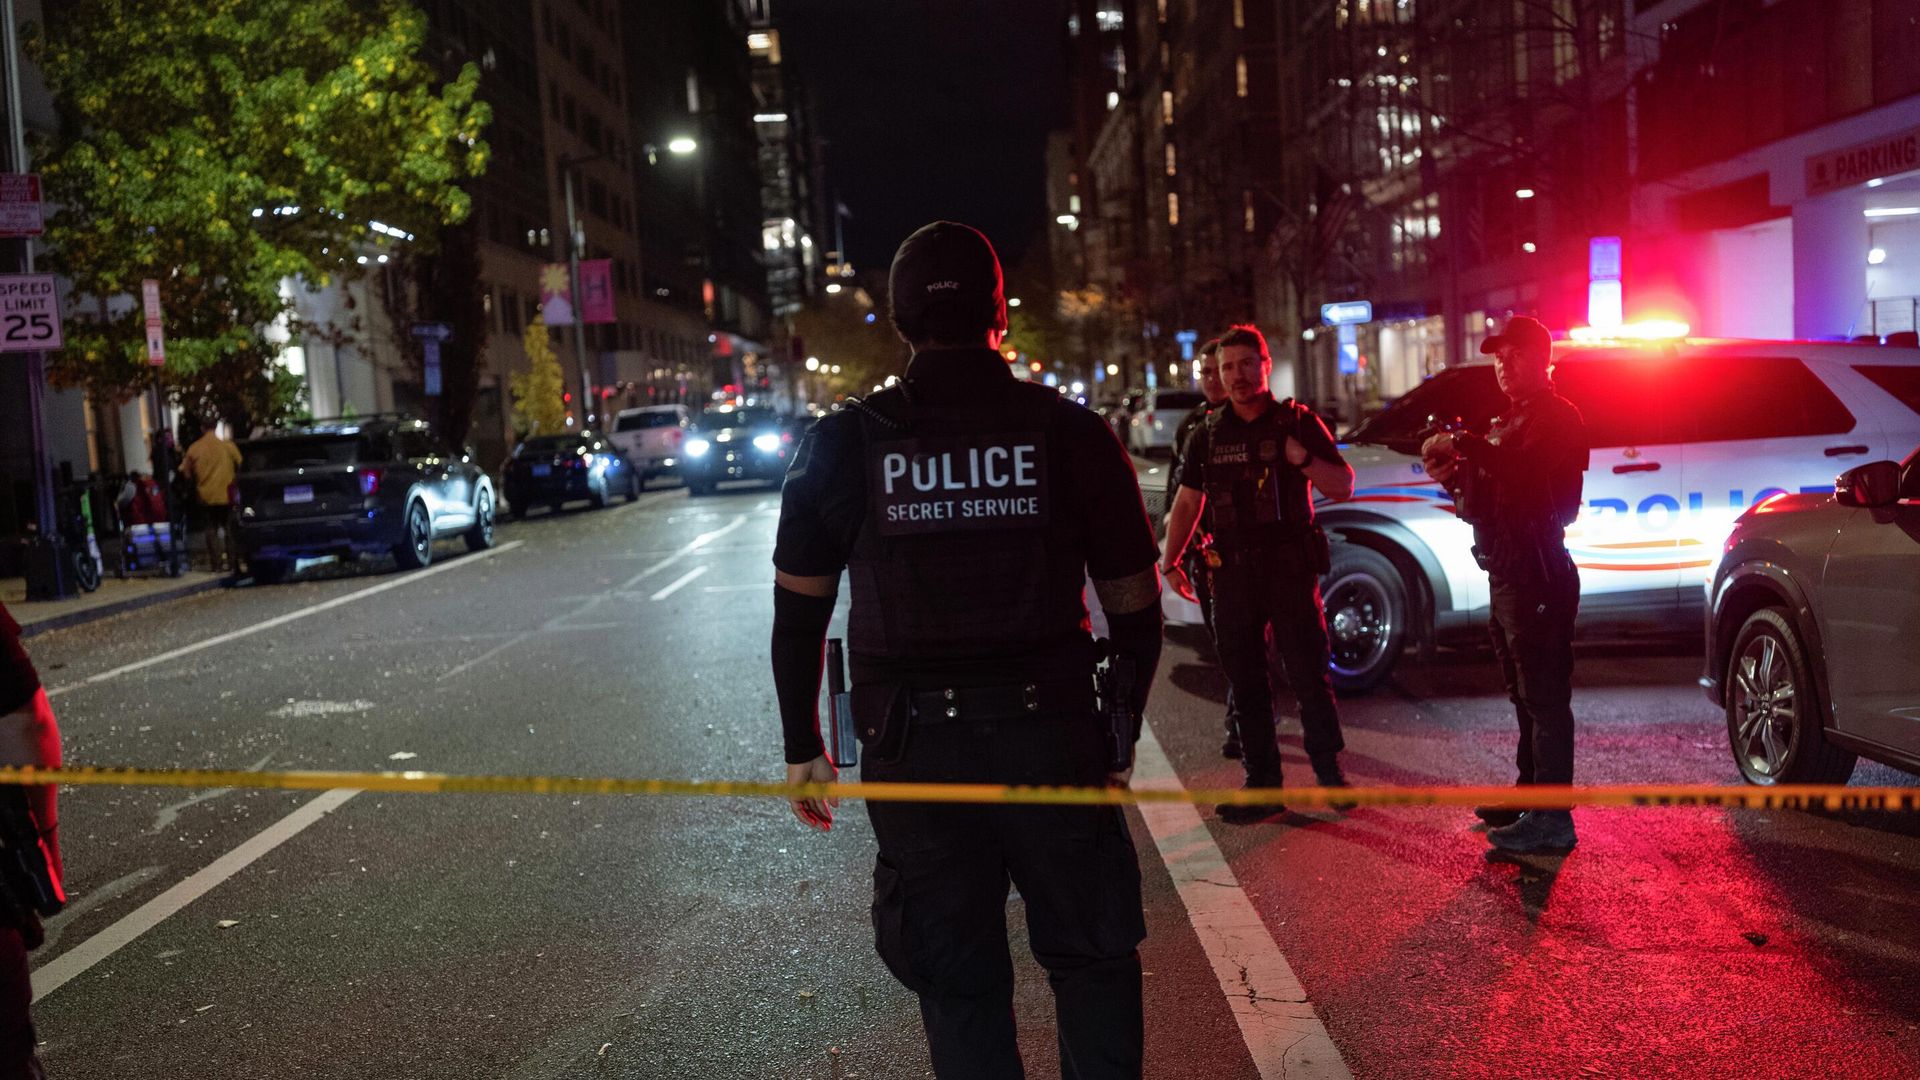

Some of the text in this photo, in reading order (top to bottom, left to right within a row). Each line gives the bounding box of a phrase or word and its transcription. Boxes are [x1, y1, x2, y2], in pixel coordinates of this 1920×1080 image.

[1836, 135, 1916, 181] PARKING
[0, 282, 52, 296] SPEED
[926, 280, 961, 293] POLICE
[4, 298, 46, 311] LIMIT
[5, 314, 53, 341] 25
[1215, 443, 1246, 454] SECRET
[1212, 453, 1249, 464] SERVICE
[883, 445, 1037, 494] POLICE
[887, 497, 1039, 521] SECRET SERVICE
